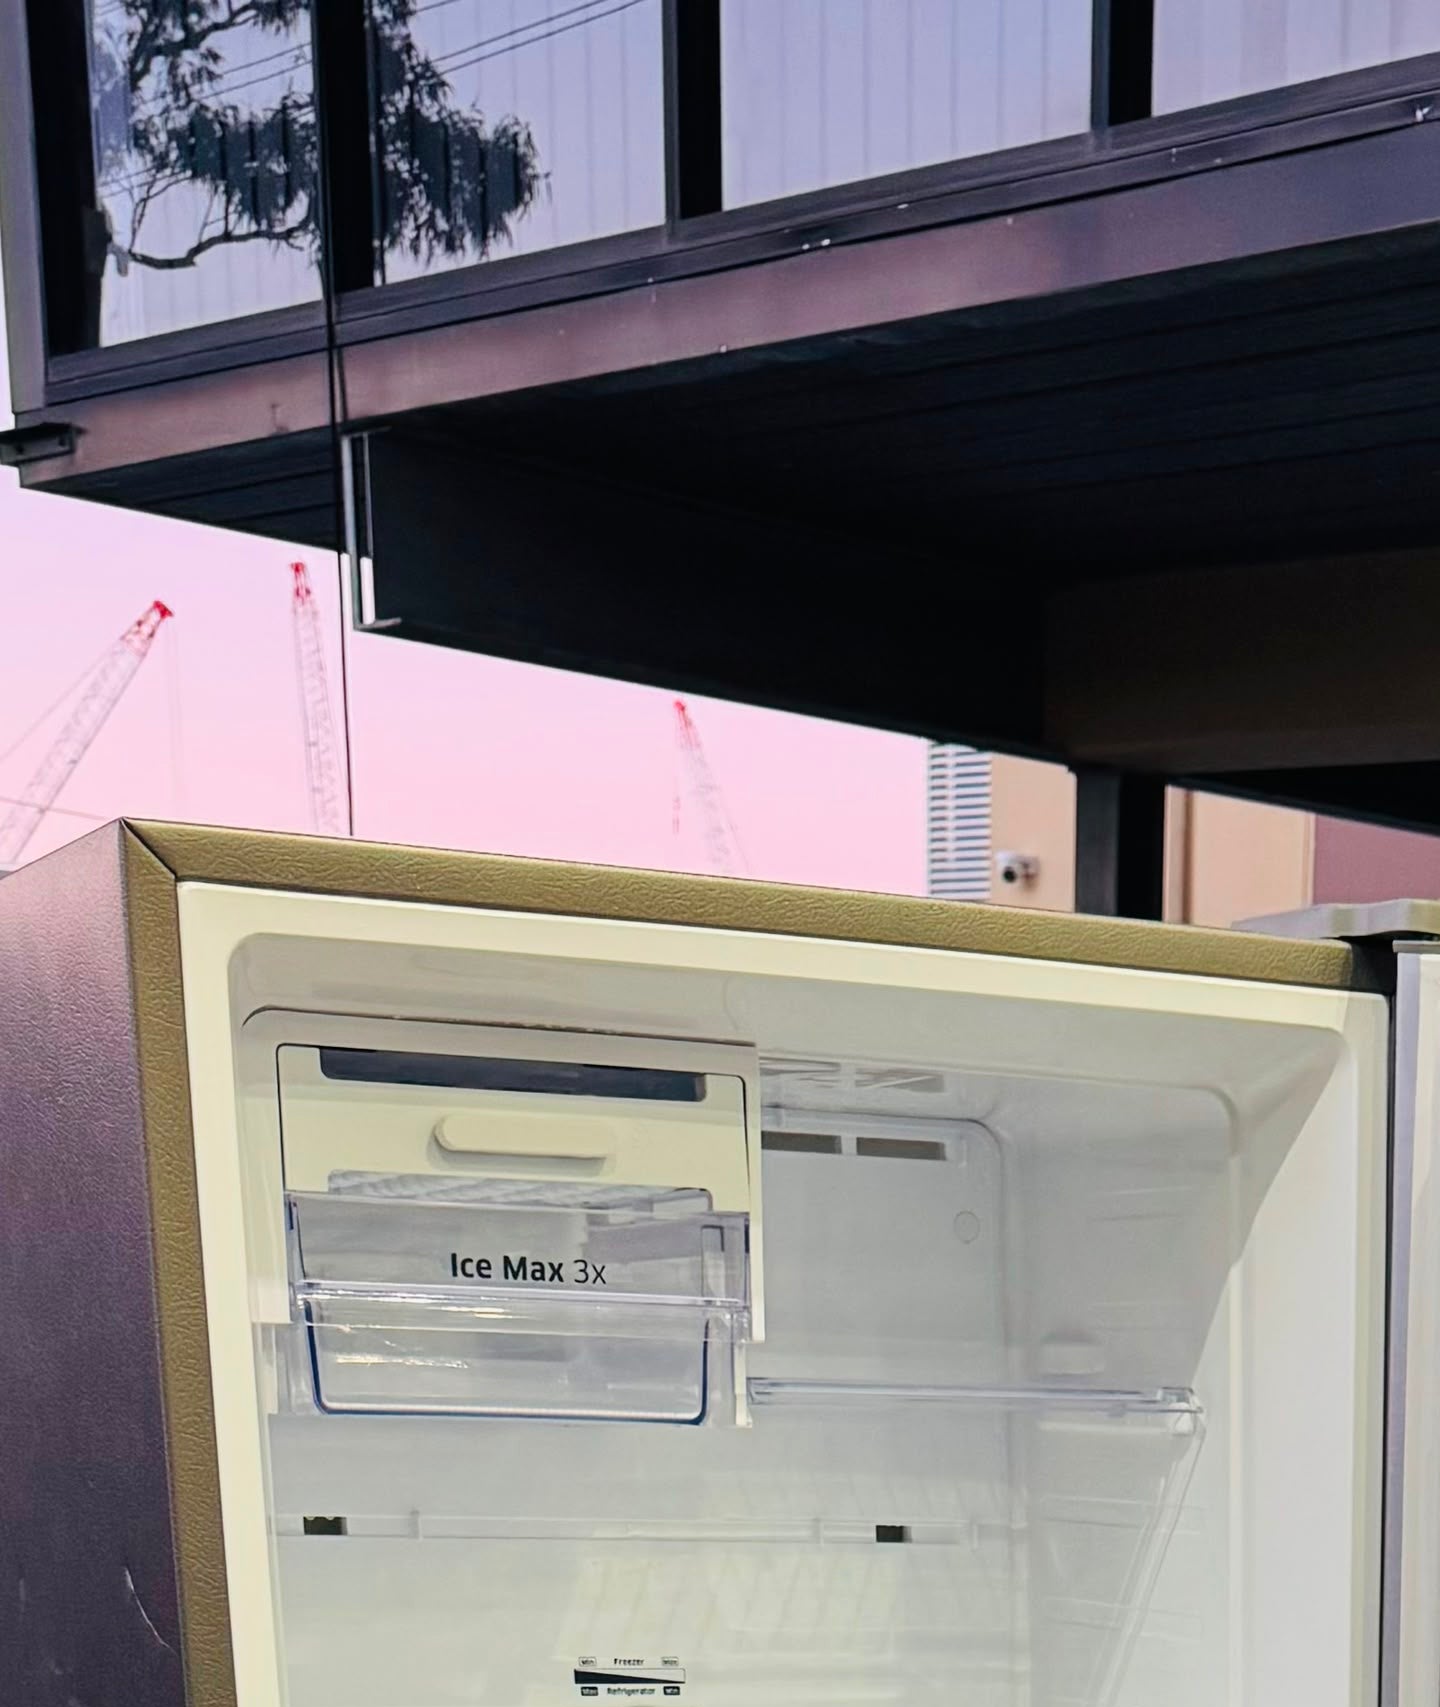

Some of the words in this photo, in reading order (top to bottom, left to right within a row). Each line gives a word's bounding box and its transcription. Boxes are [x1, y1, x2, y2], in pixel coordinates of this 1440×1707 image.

[451, 1253, 492, 1279] Ice
[503, 1255, 564, 1283] Max
[573, 1259, 606, 1284] 3x
[613, 1658, 645, 1666] Freezer
[607, 1687, 656, 1696] Refrigerator
